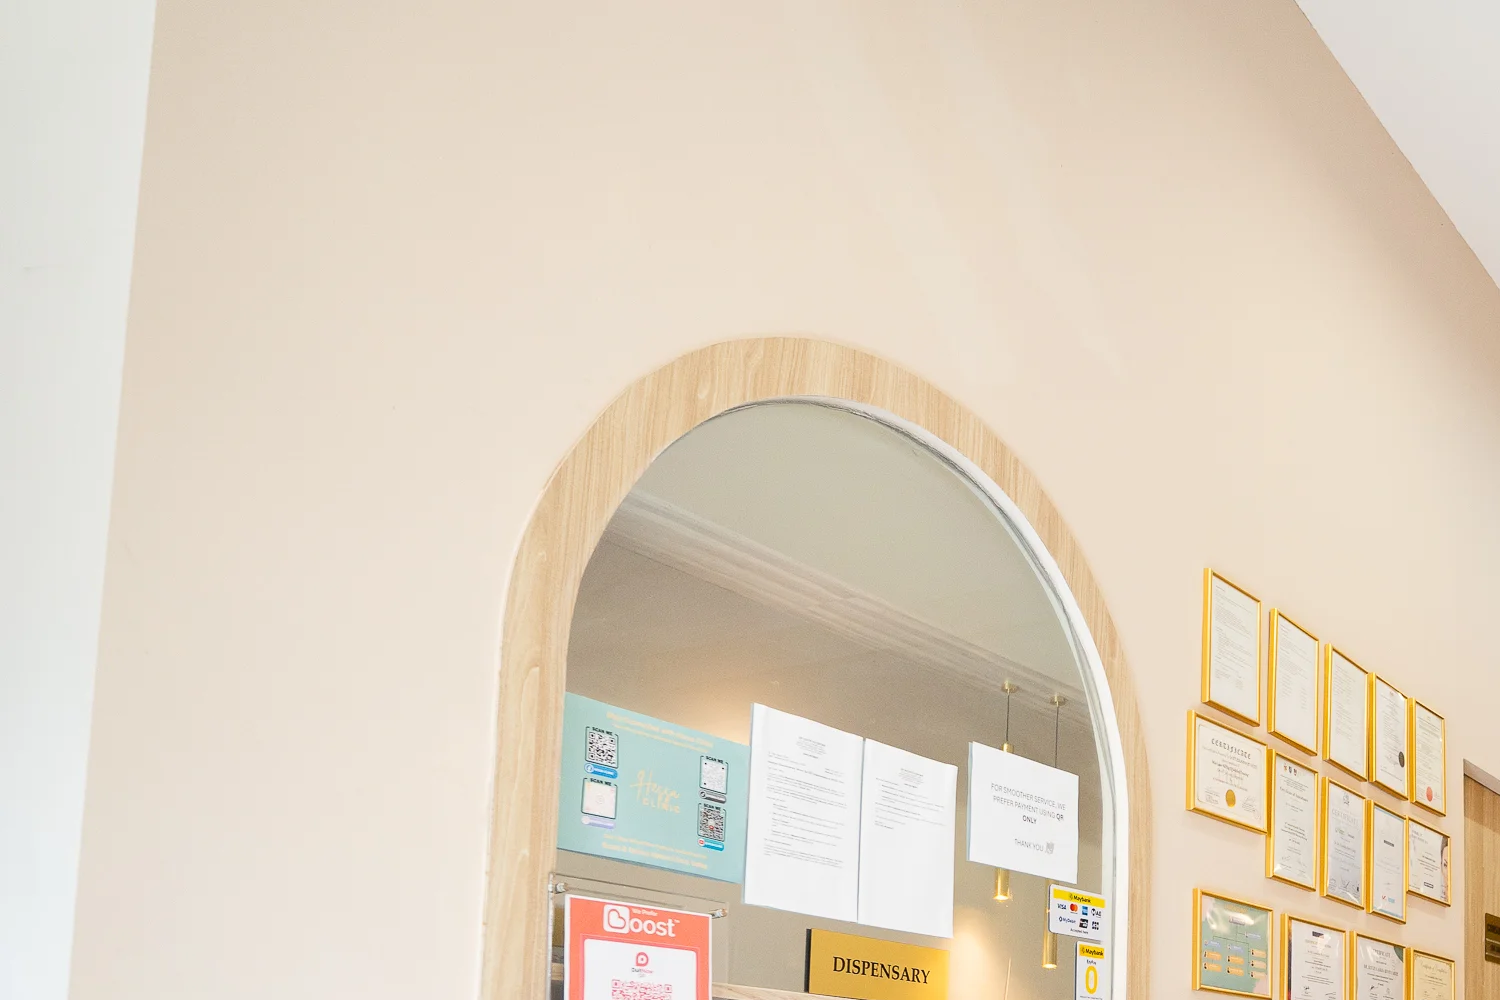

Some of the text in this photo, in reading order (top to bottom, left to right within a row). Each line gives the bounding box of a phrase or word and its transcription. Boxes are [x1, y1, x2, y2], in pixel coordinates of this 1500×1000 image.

[991, 783, 1002, 792] FOR
[1003, 786, 1033, 801] SMOOTHER
[1057, 802, 1066, 811] WE
[993, 795, 1064, 821] PREFER PAYMENT USING QR
[1022, 815, 1037, 825] ONLY
[1014, 838, 1044, 852] THANK YOU
[1073, 895, 1091, 903] Maybank
[1085, 948, 1103, 956] Maybank
[833, 956, 930, 984] DISPENSARY
